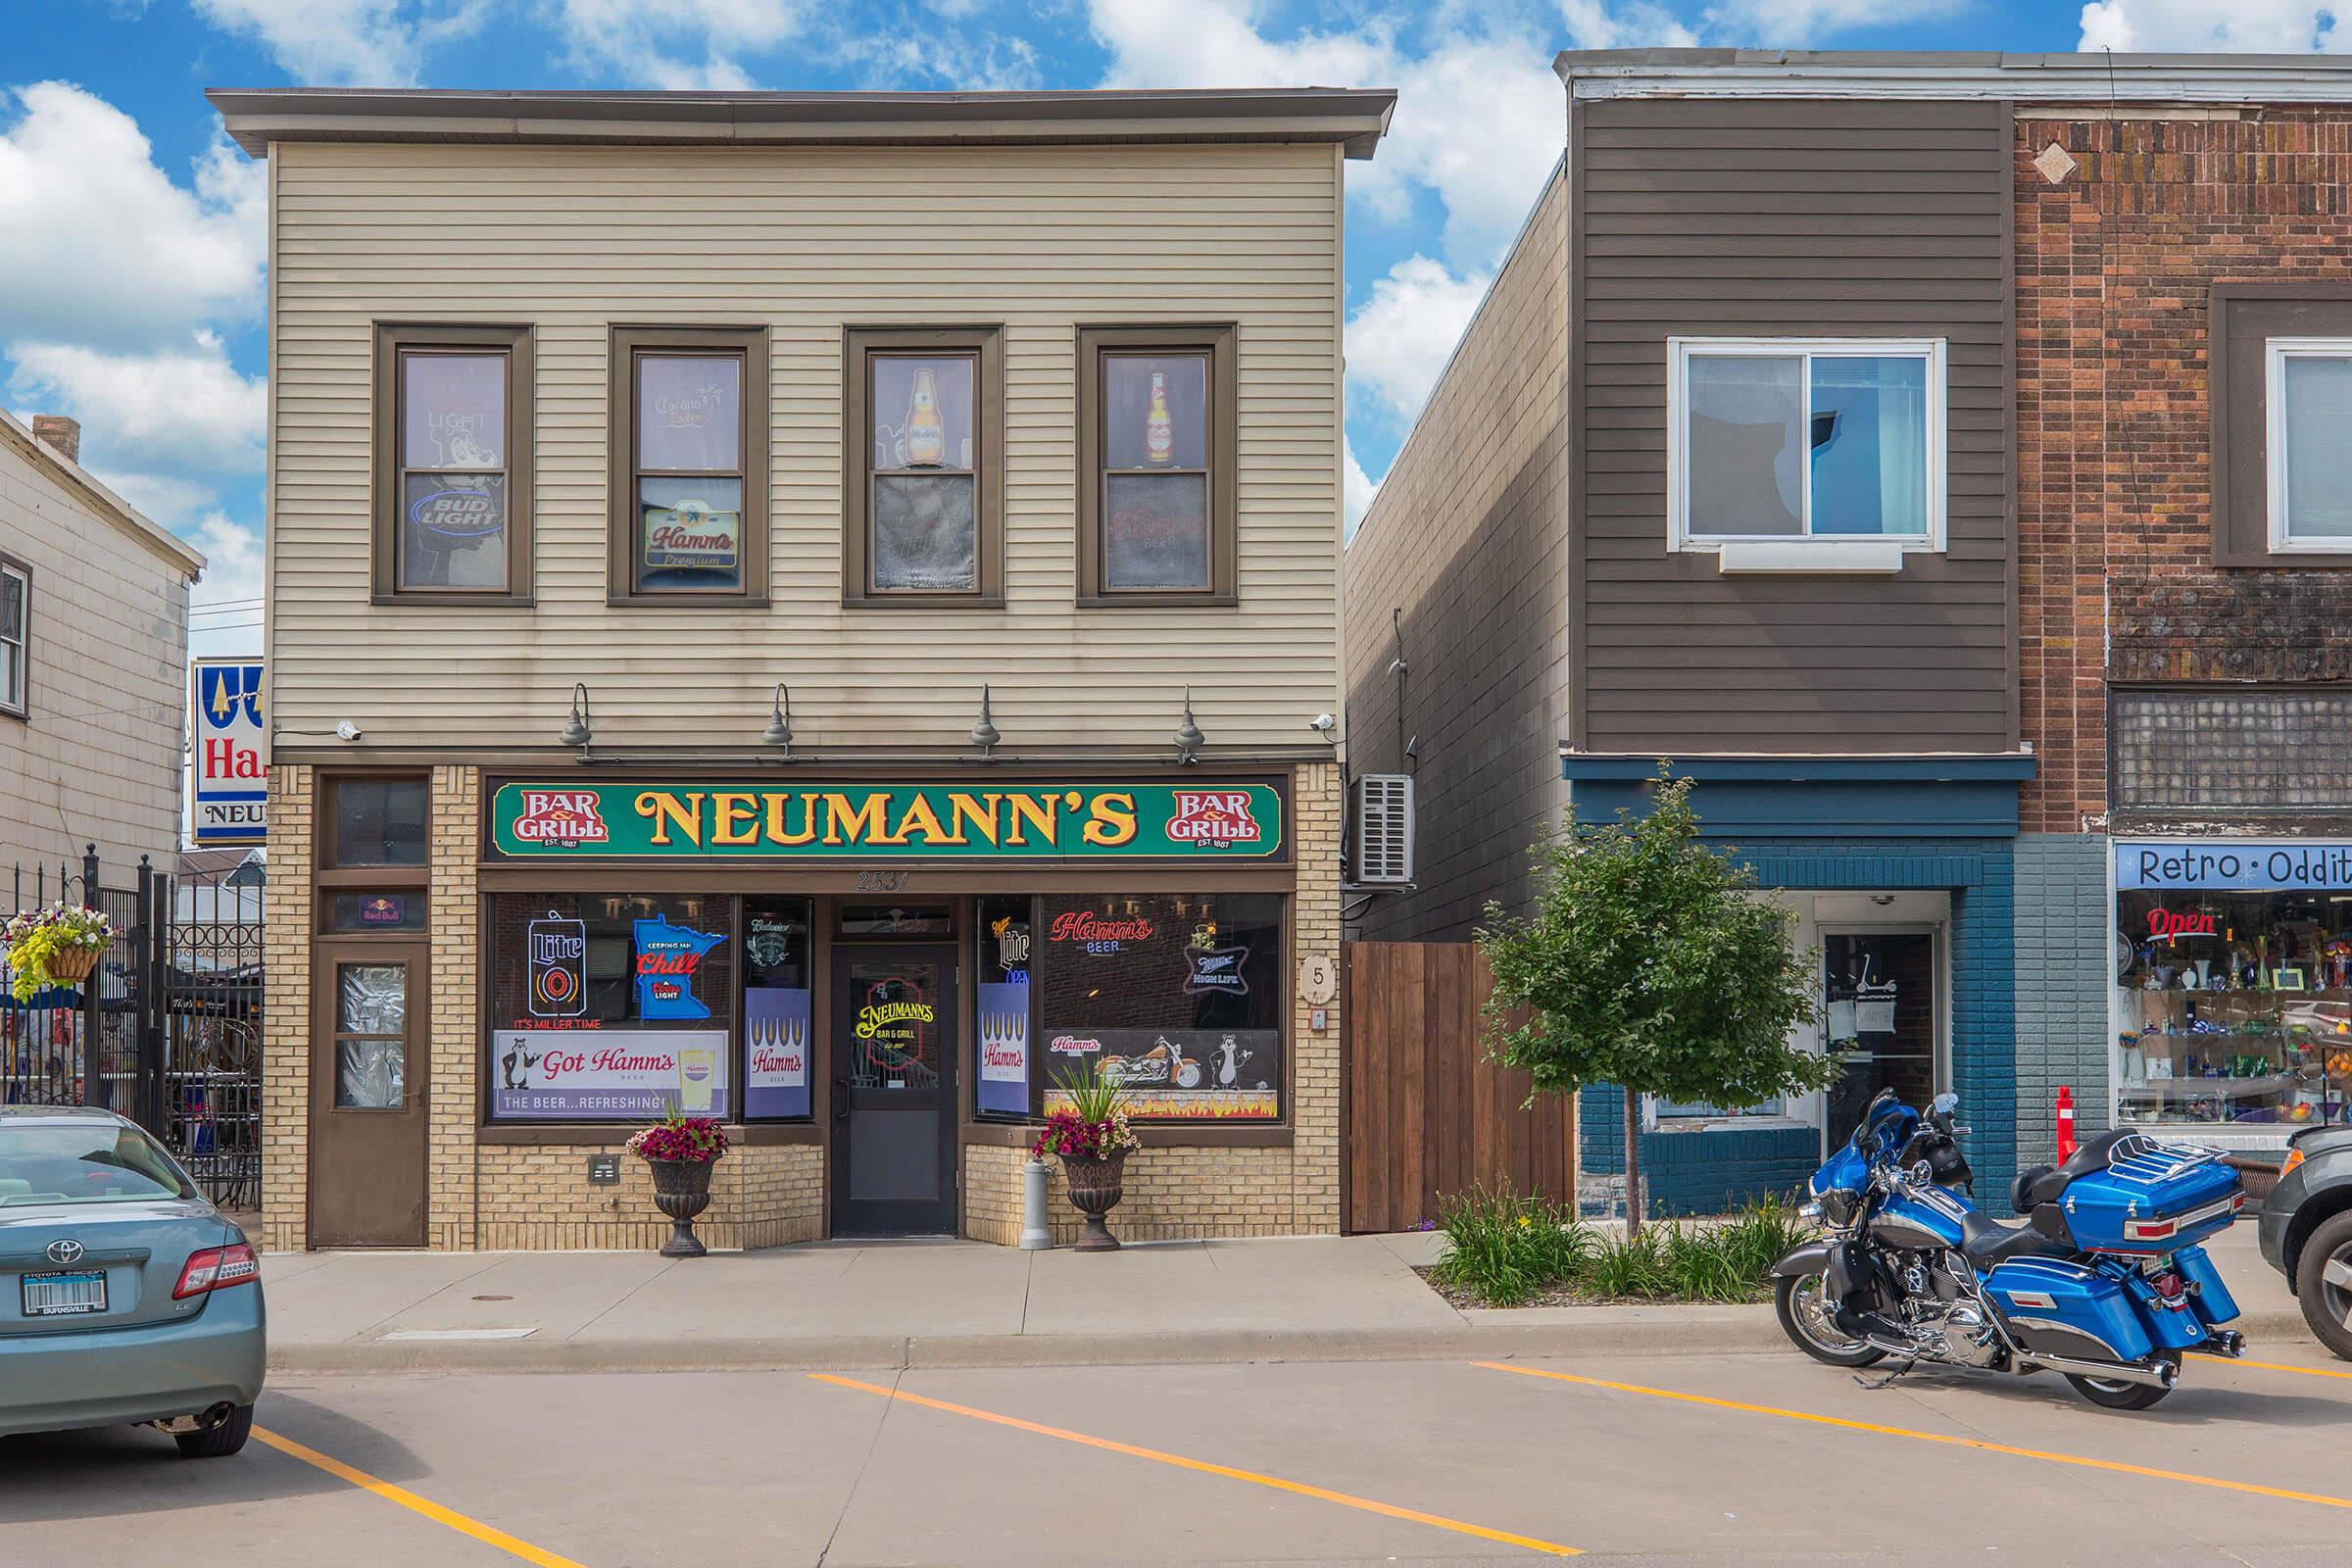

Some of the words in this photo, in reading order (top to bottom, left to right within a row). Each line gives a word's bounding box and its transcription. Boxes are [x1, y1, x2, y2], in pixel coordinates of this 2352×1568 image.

[434, 500, 488, 512] BUD
[422, 513, 498, 524] LIGHT
[664, 554, 719, 565] Premium
[205, 737, 267, 779] Ha
[205, 805, 267, 823] NEU
[529, 795, 596, 819] BAR
[551, 810, 575, 820] &
[1181, 795, 1250, 820] BAR
[1202, 810, 1227, 821] &
[517, 819, 604, 838] GRILL
[634, 791, 1139, 849] NEUMANN'S
[1171, 820, 1255, 838] GRILL
[2140, 849, 2240, 884] Retro
[364, 910, 381, 919] Red
[1050, 910, 1153, 942] Hamm's
[2147, 908, 2215, 943] Open
[532, 933, 582, 965] Lite
[1000, 931, 1029, 970] Lite
[1086, 941, 1119, 954] BEER
[636, 952, 701, 975] Chill
[1194, 974, 1217, 984] HIGH
[1218, 974, 1240, 984] LIFE
[1313, 967, 1324, 985] 5
[514, 1018, 532, 1029] IT'S
[534, 1019, 572, 1029] MILLER
[575, 1019, 602, 1029] TIME
[876, 1029, 891, 1038] BAR
[897, 1029, 915, 1038] GRILL
[752, 1048, 803, 1074] Hamm's
[984, 1042, 1023, 1067] Hamm's
[542, 1050, 585, 1080] Got
[590, 1048, 675, 1072] Hamm's
[504, 1097, 528, 1109] THE
